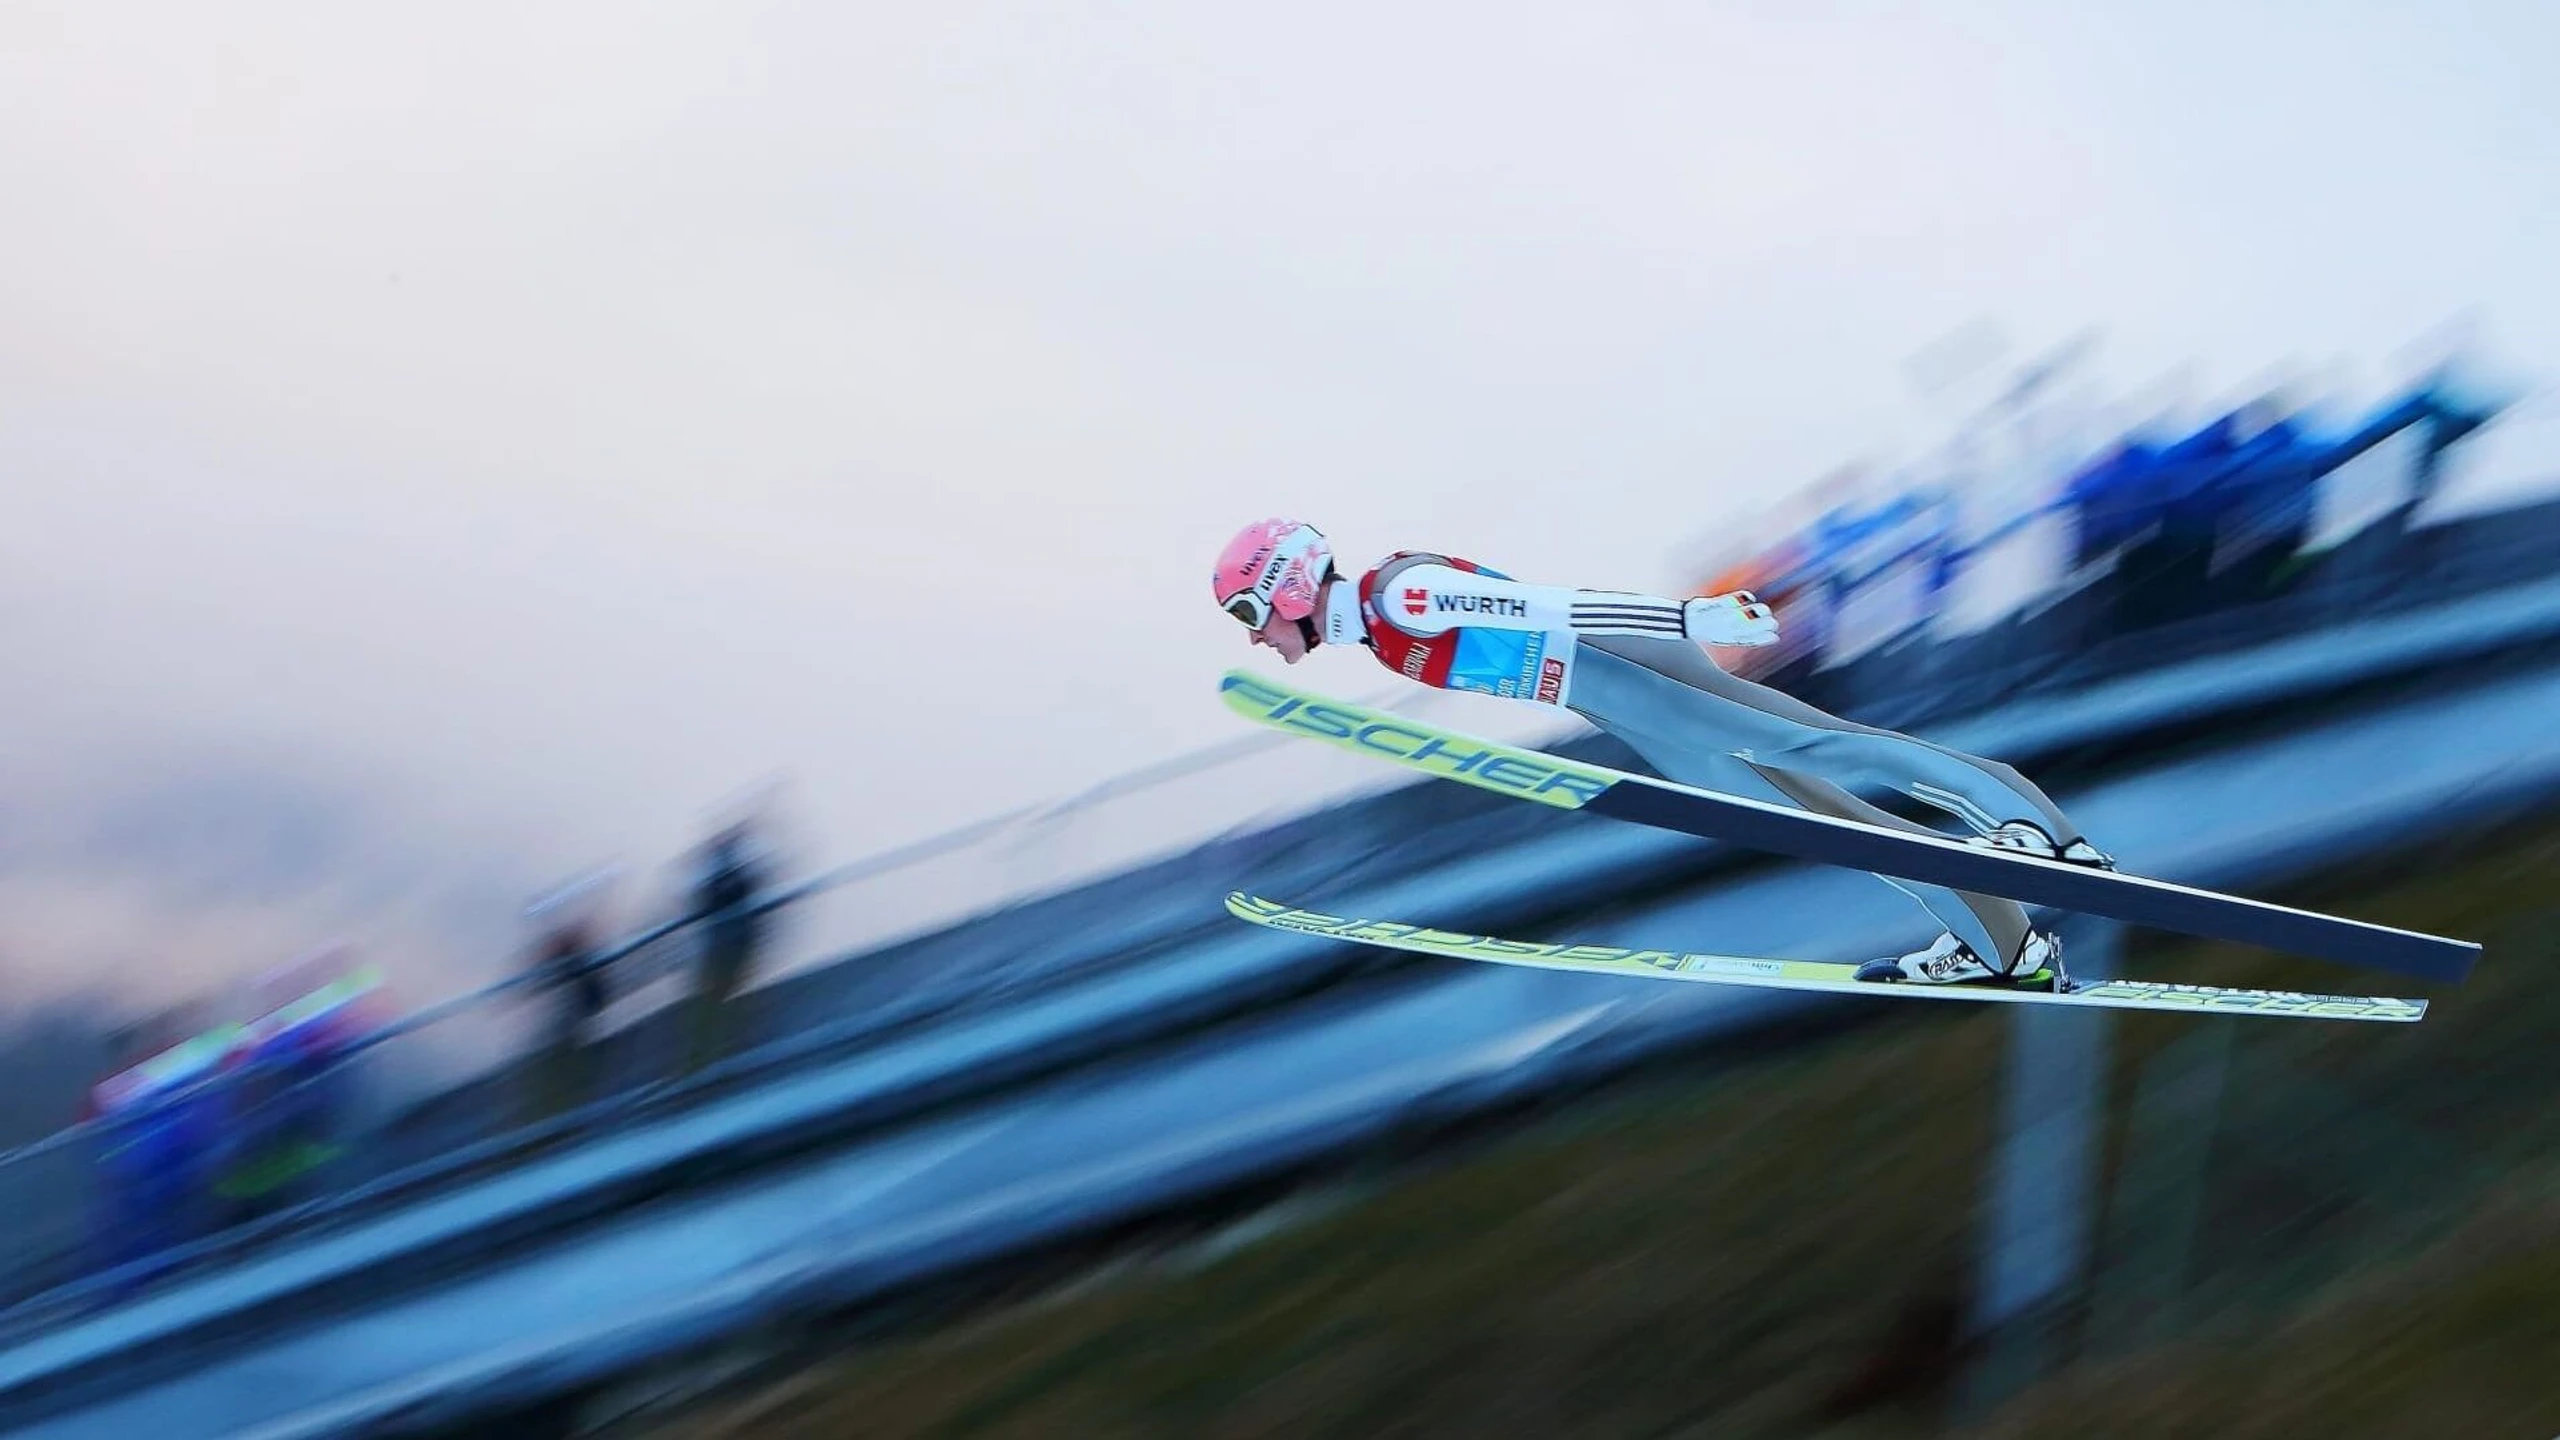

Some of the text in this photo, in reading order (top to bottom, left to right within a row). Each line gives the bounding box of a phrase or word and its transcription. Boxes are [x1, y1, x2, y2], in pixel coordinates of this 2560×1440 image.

[1261, 554, 1289, 592] uvex
[1432, 593, 1527, 617] WÜRTH
[1221, 676, 1609, 802] FISCHER
